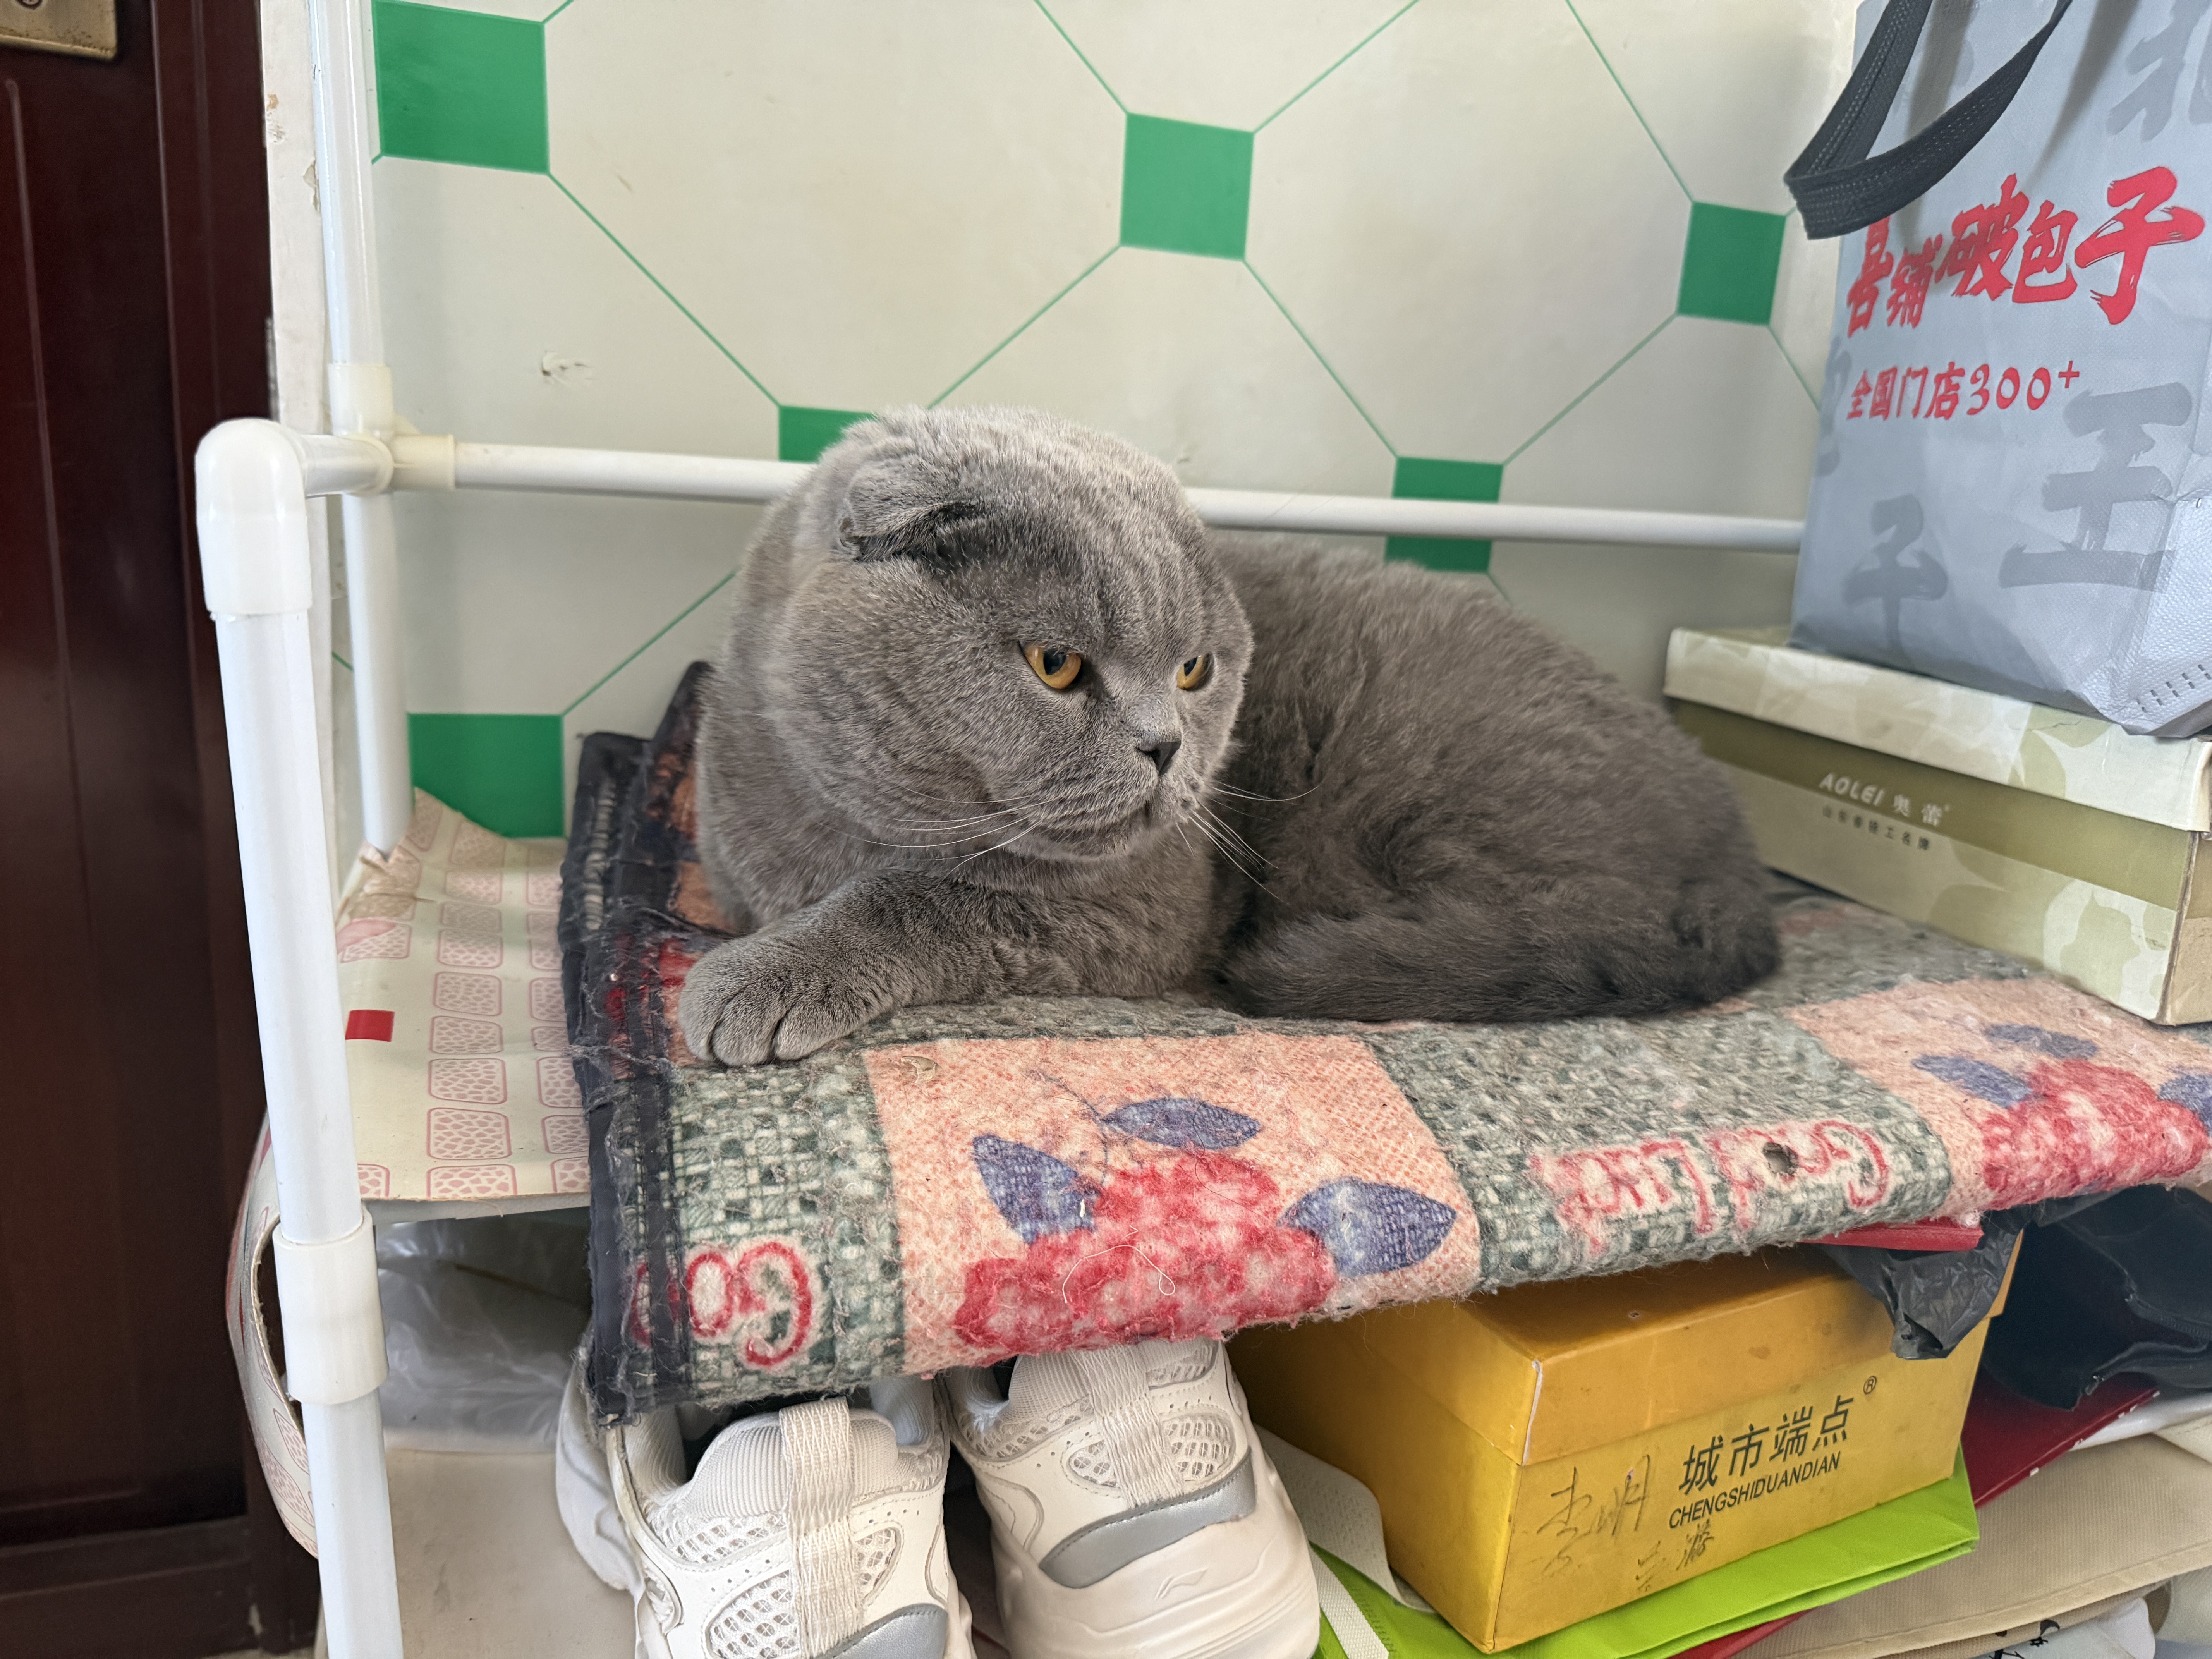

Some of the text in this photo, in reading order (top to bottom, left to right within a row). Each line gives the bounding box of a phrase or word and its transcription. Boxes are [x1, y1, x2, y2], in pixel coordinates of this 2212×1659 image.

[1819, 773, 1885, 806] AOLEI
[1678, 1395, 1854, 1496] 城市端点
[1669, 1451, 1841, 1529] CHENGSHIDUANDIAN
